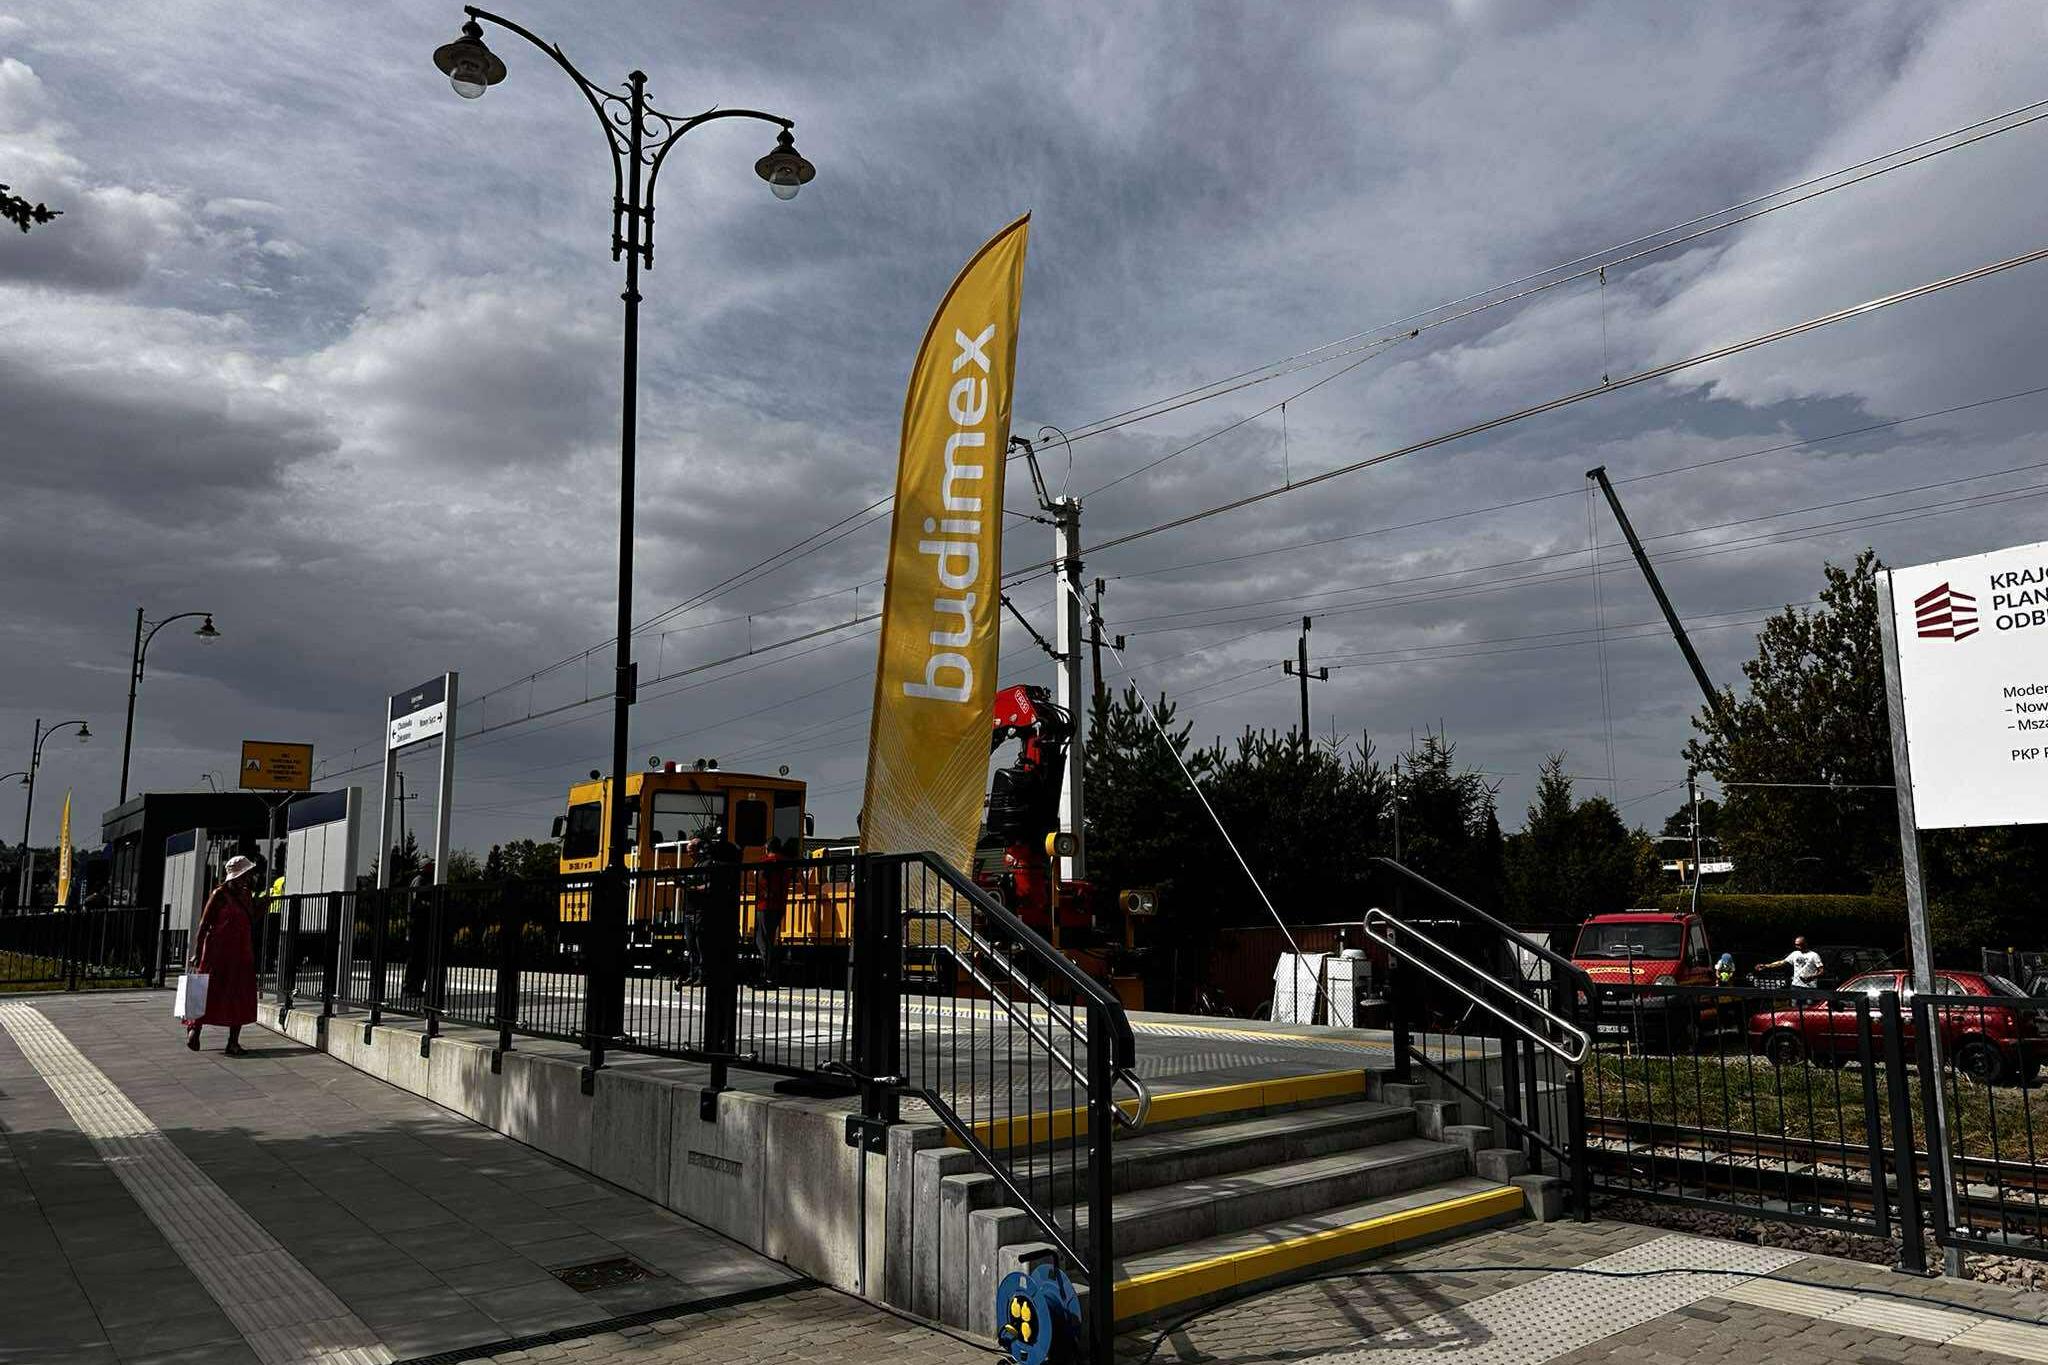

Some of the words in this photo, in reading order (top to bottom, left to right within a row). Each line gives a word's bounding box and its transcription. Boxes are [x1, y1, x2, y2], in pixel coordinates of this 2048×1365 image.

[903, 323, 995, 703] budimex
[1990, 566, 2048, 590] KRAJ
[1996, 609, 2048, 630] ODB
[2011, 747, 2039, 761] PKP
